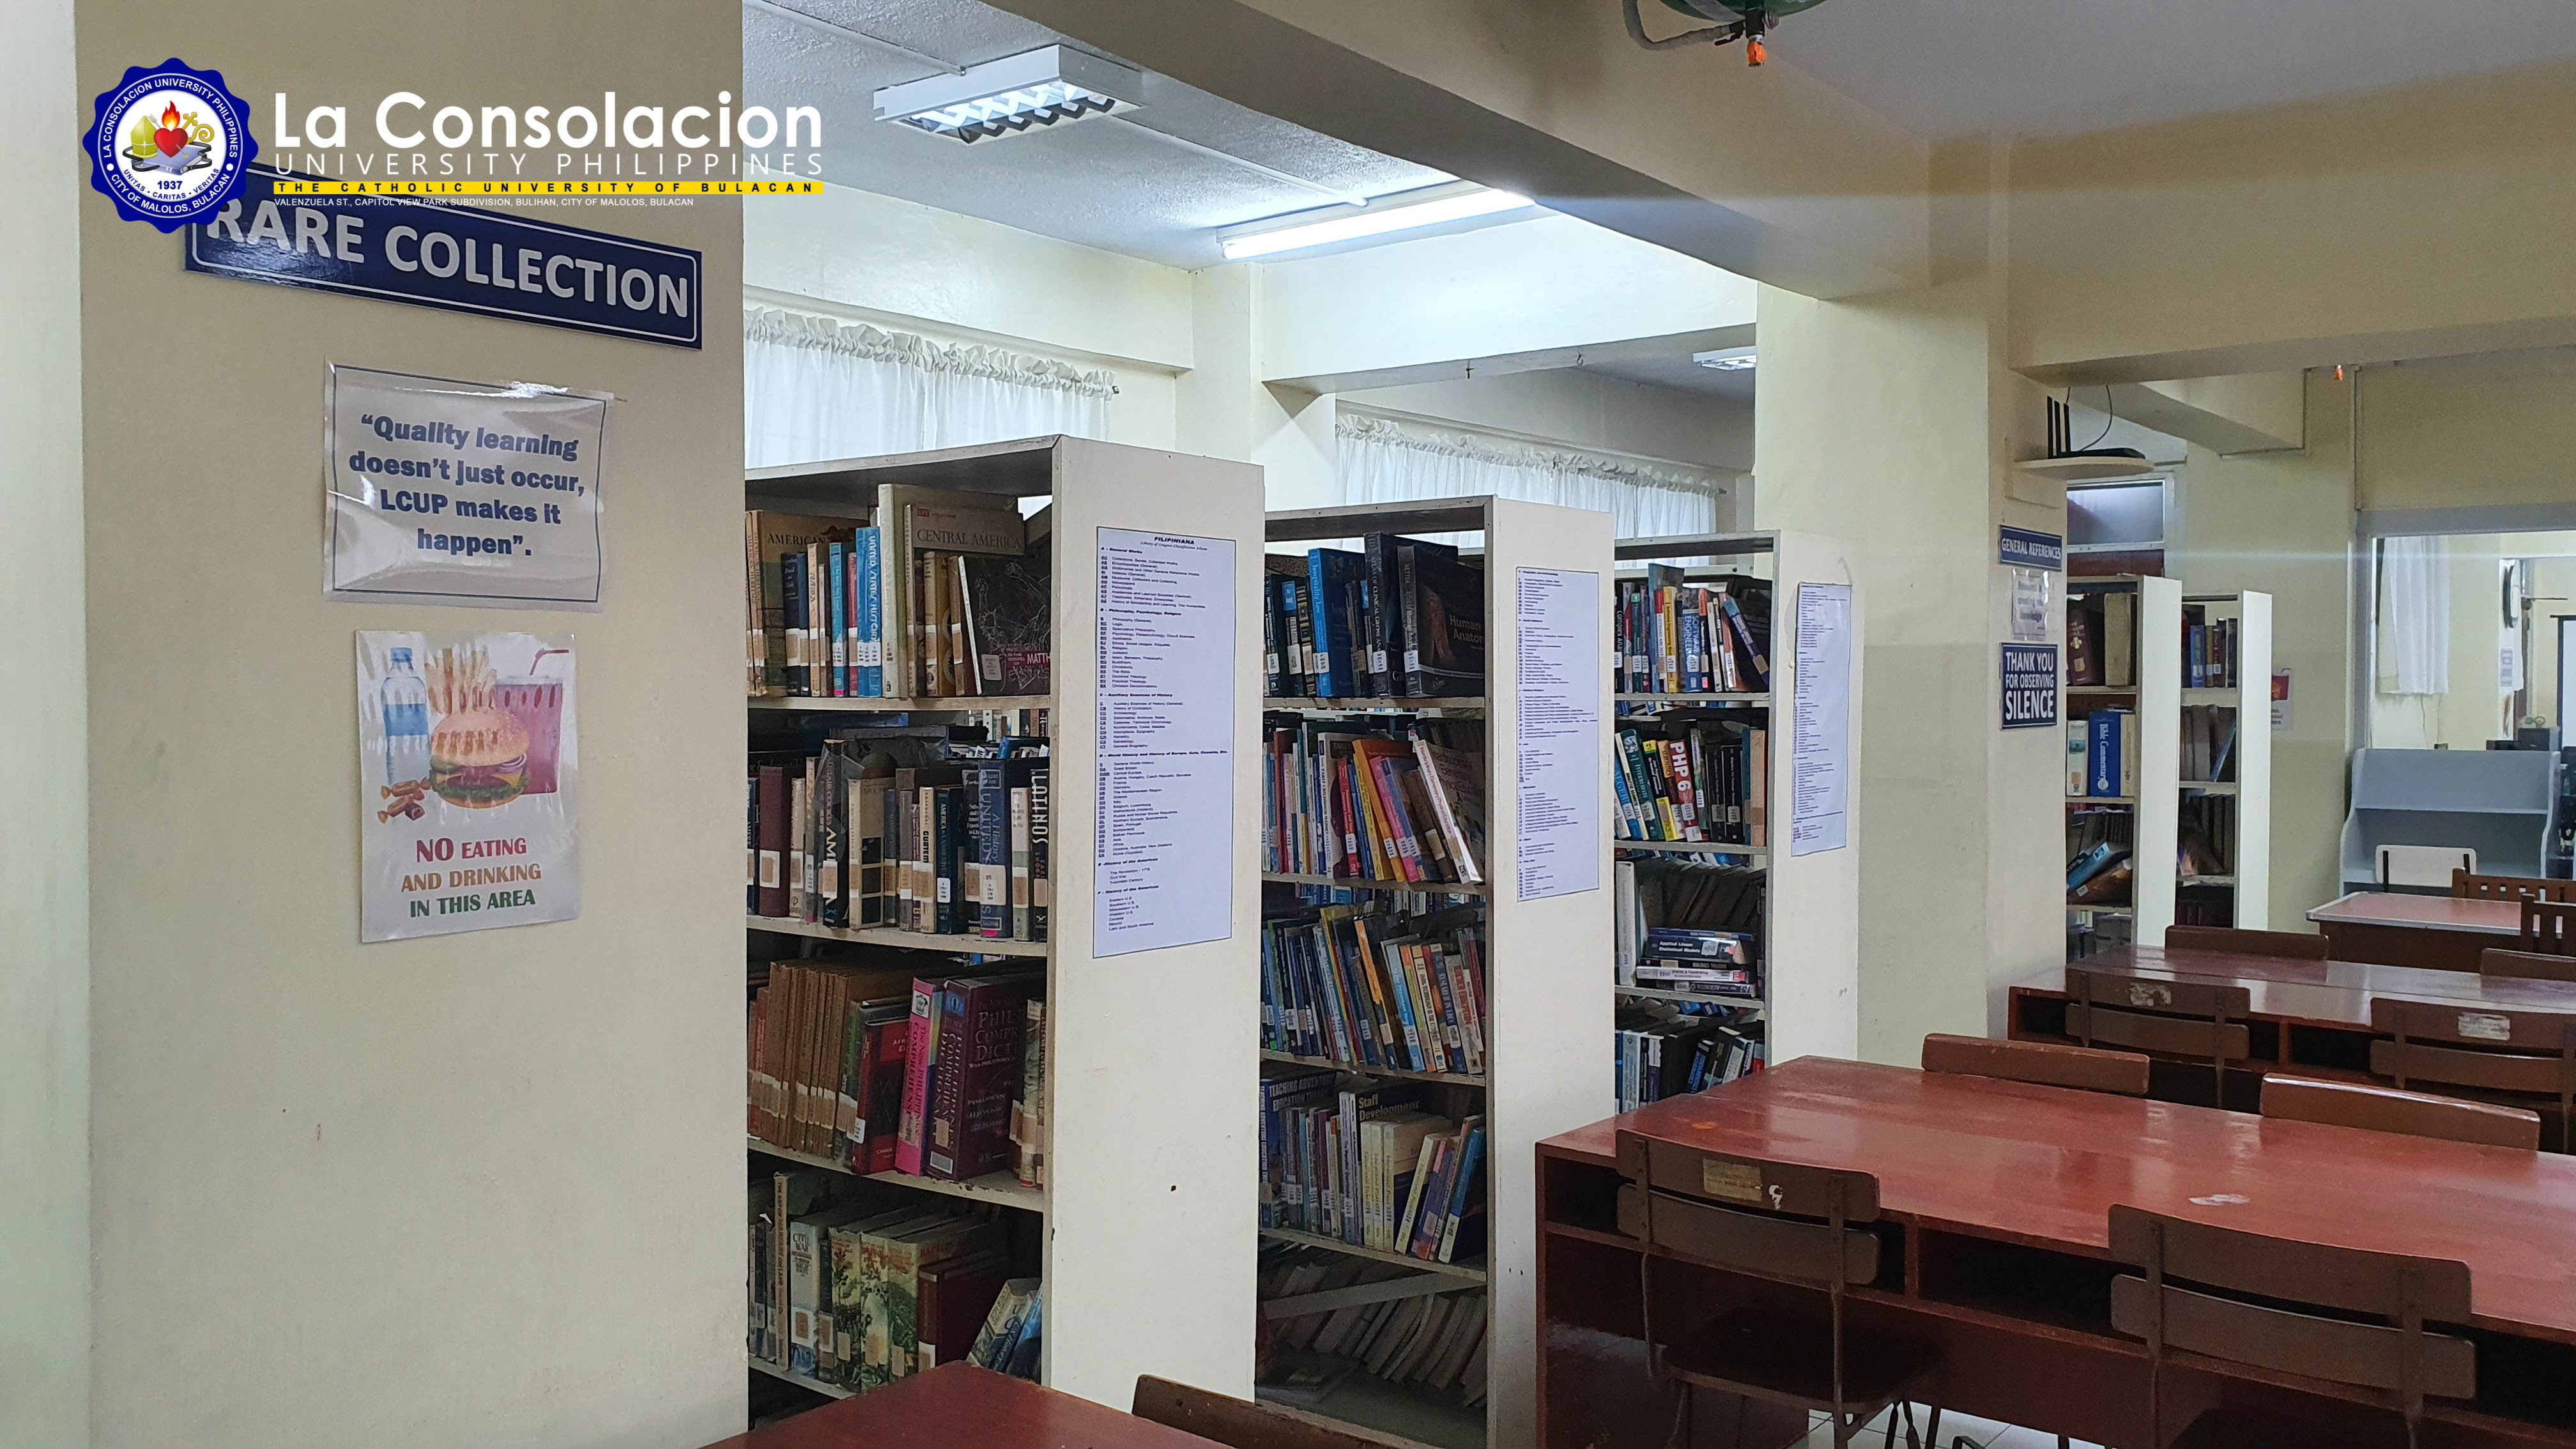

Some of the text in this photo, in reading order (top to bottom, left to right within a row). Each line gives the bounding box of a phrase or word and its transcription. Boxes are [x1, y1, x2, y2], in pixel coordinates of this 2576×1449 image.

[206, 199, 688, 318] RARE COLLECTION
[477, 427, 579, 462] learning
[456, 460, 505, 486] just
[511, 470, 585, 497] occur,
[380, 489, 561, 524] LCUP makes it
[868, 535, 877, 566] UNITED
[917, 529, 1022, 549] CENTRAL AMERICA
[2002, 538, 2061, 559] GENERAL REFERENCES
[868, 569, 877, 600] STATES
[1312, 564, 1322, 605] hospitality
[1450, 615, 1481, 629] Human
[2005, 652, 2053, 671] THANK YOU
[2005, 674, 2054, 688] FOR OBSERVING
[2005, 690, 2054, 721] SILENCE
[2099, 724, 2108, 740] Bible
[1669, 741, 1692, 792] PHP 6
[1032, 775, 1049, 844] LATINOS
[417, 838, 527, 862] NO EATING
[401, 864, 541, 893] AND DRINKING
[410, 889, 536, 917] IN THIS AREA
[1358, 1094, 1379, 1108] Staff
